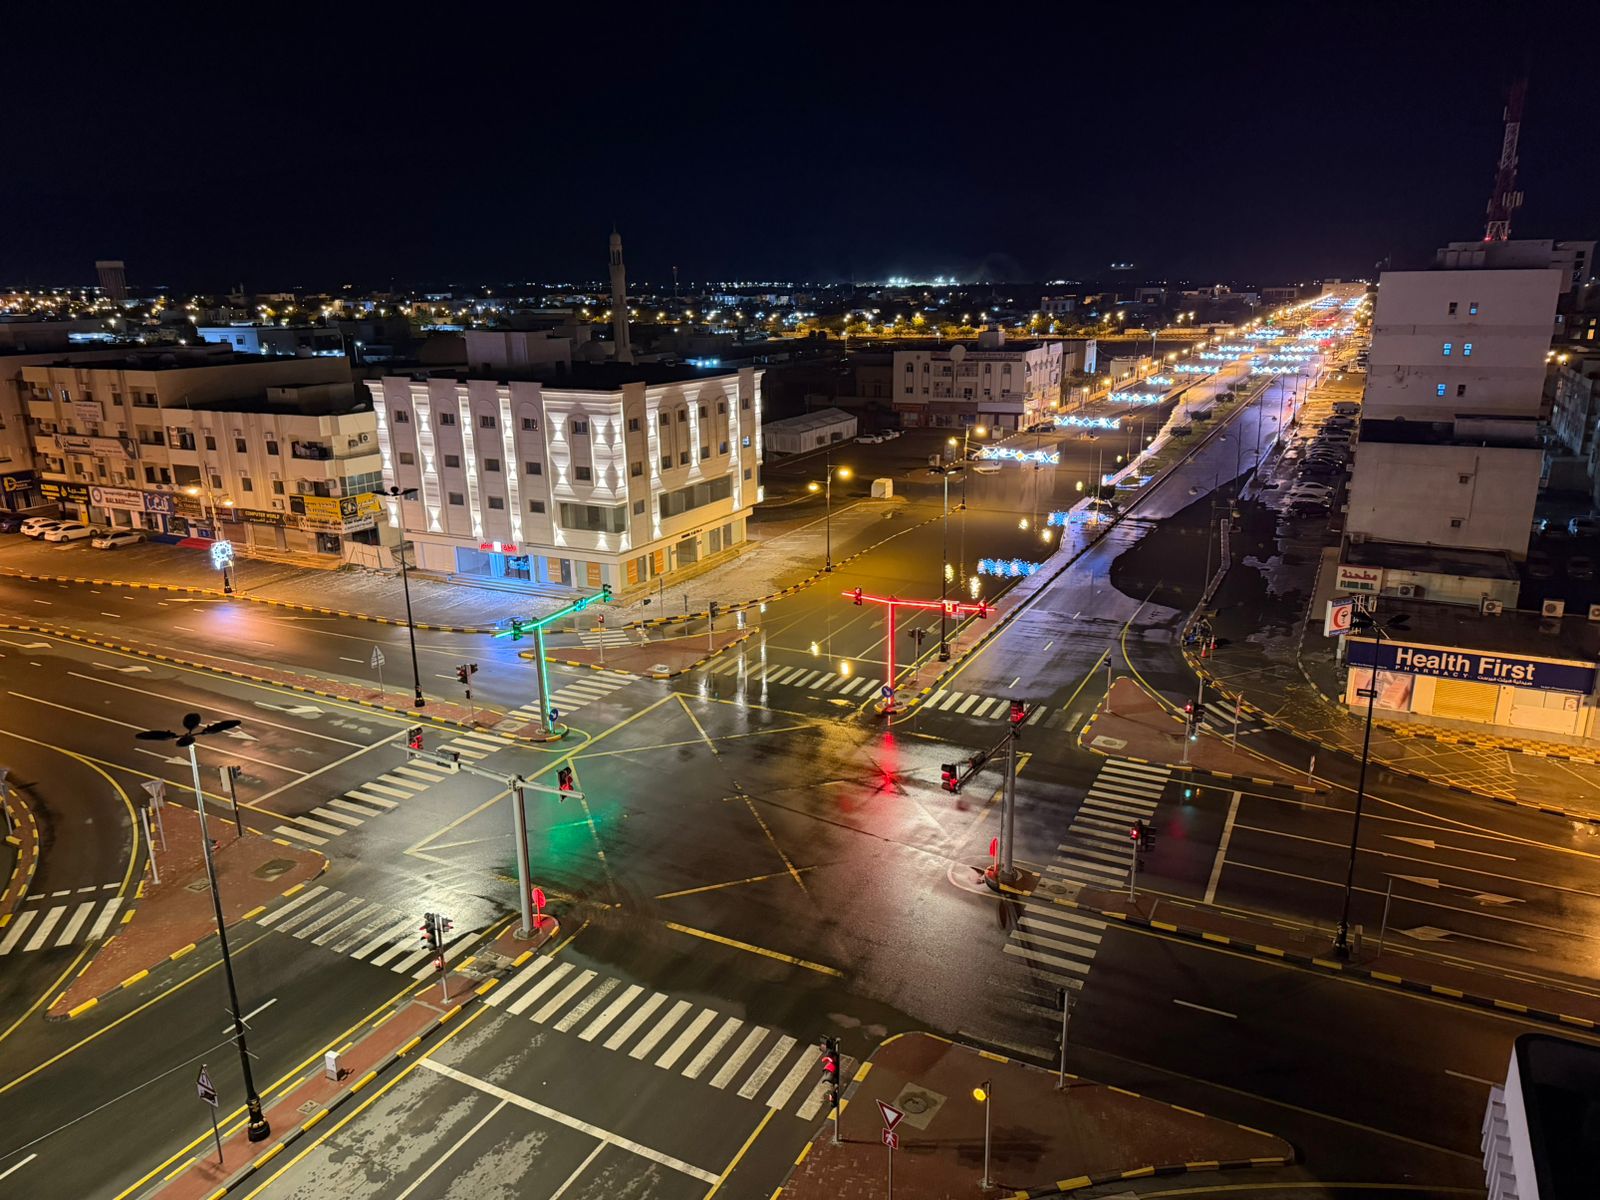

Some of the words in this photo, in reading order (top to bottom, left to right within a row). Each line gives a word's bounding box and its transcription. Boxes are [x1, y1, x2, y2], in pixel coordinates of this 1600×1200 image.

[1341, 569, 1377, 581] مطحنة
[1396, 647, 1471, 673] Health
[1478, 657, 1536, 680] First
[1395, 665, 1469, 678] PHARMACY
